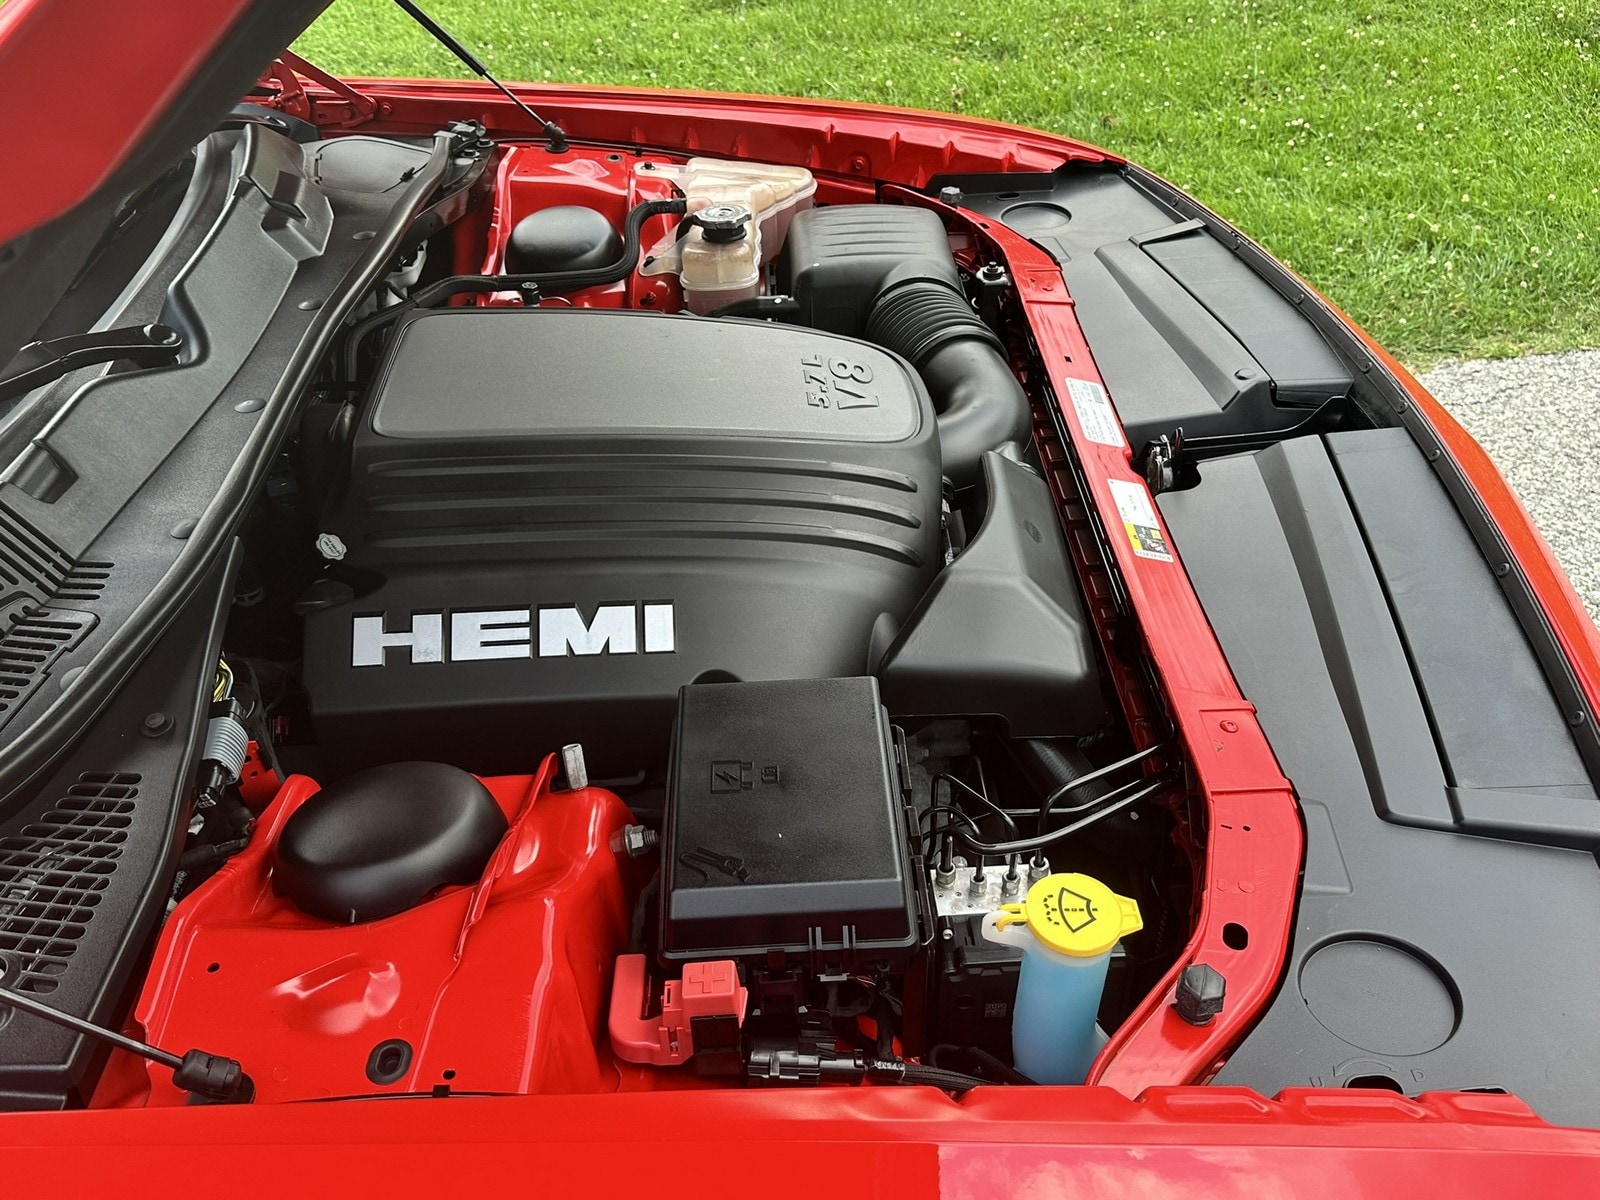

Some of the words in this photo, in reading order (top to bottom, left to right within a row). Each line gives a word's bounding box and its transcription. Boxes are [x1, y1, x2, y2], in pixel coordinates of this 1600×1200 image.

[800, 354, 831, 409] 5.7L
[828, 356, 880, 410] V8
[351, 600, 677, 667] HEMI
[1410, 1069, 1426, 1083] D
